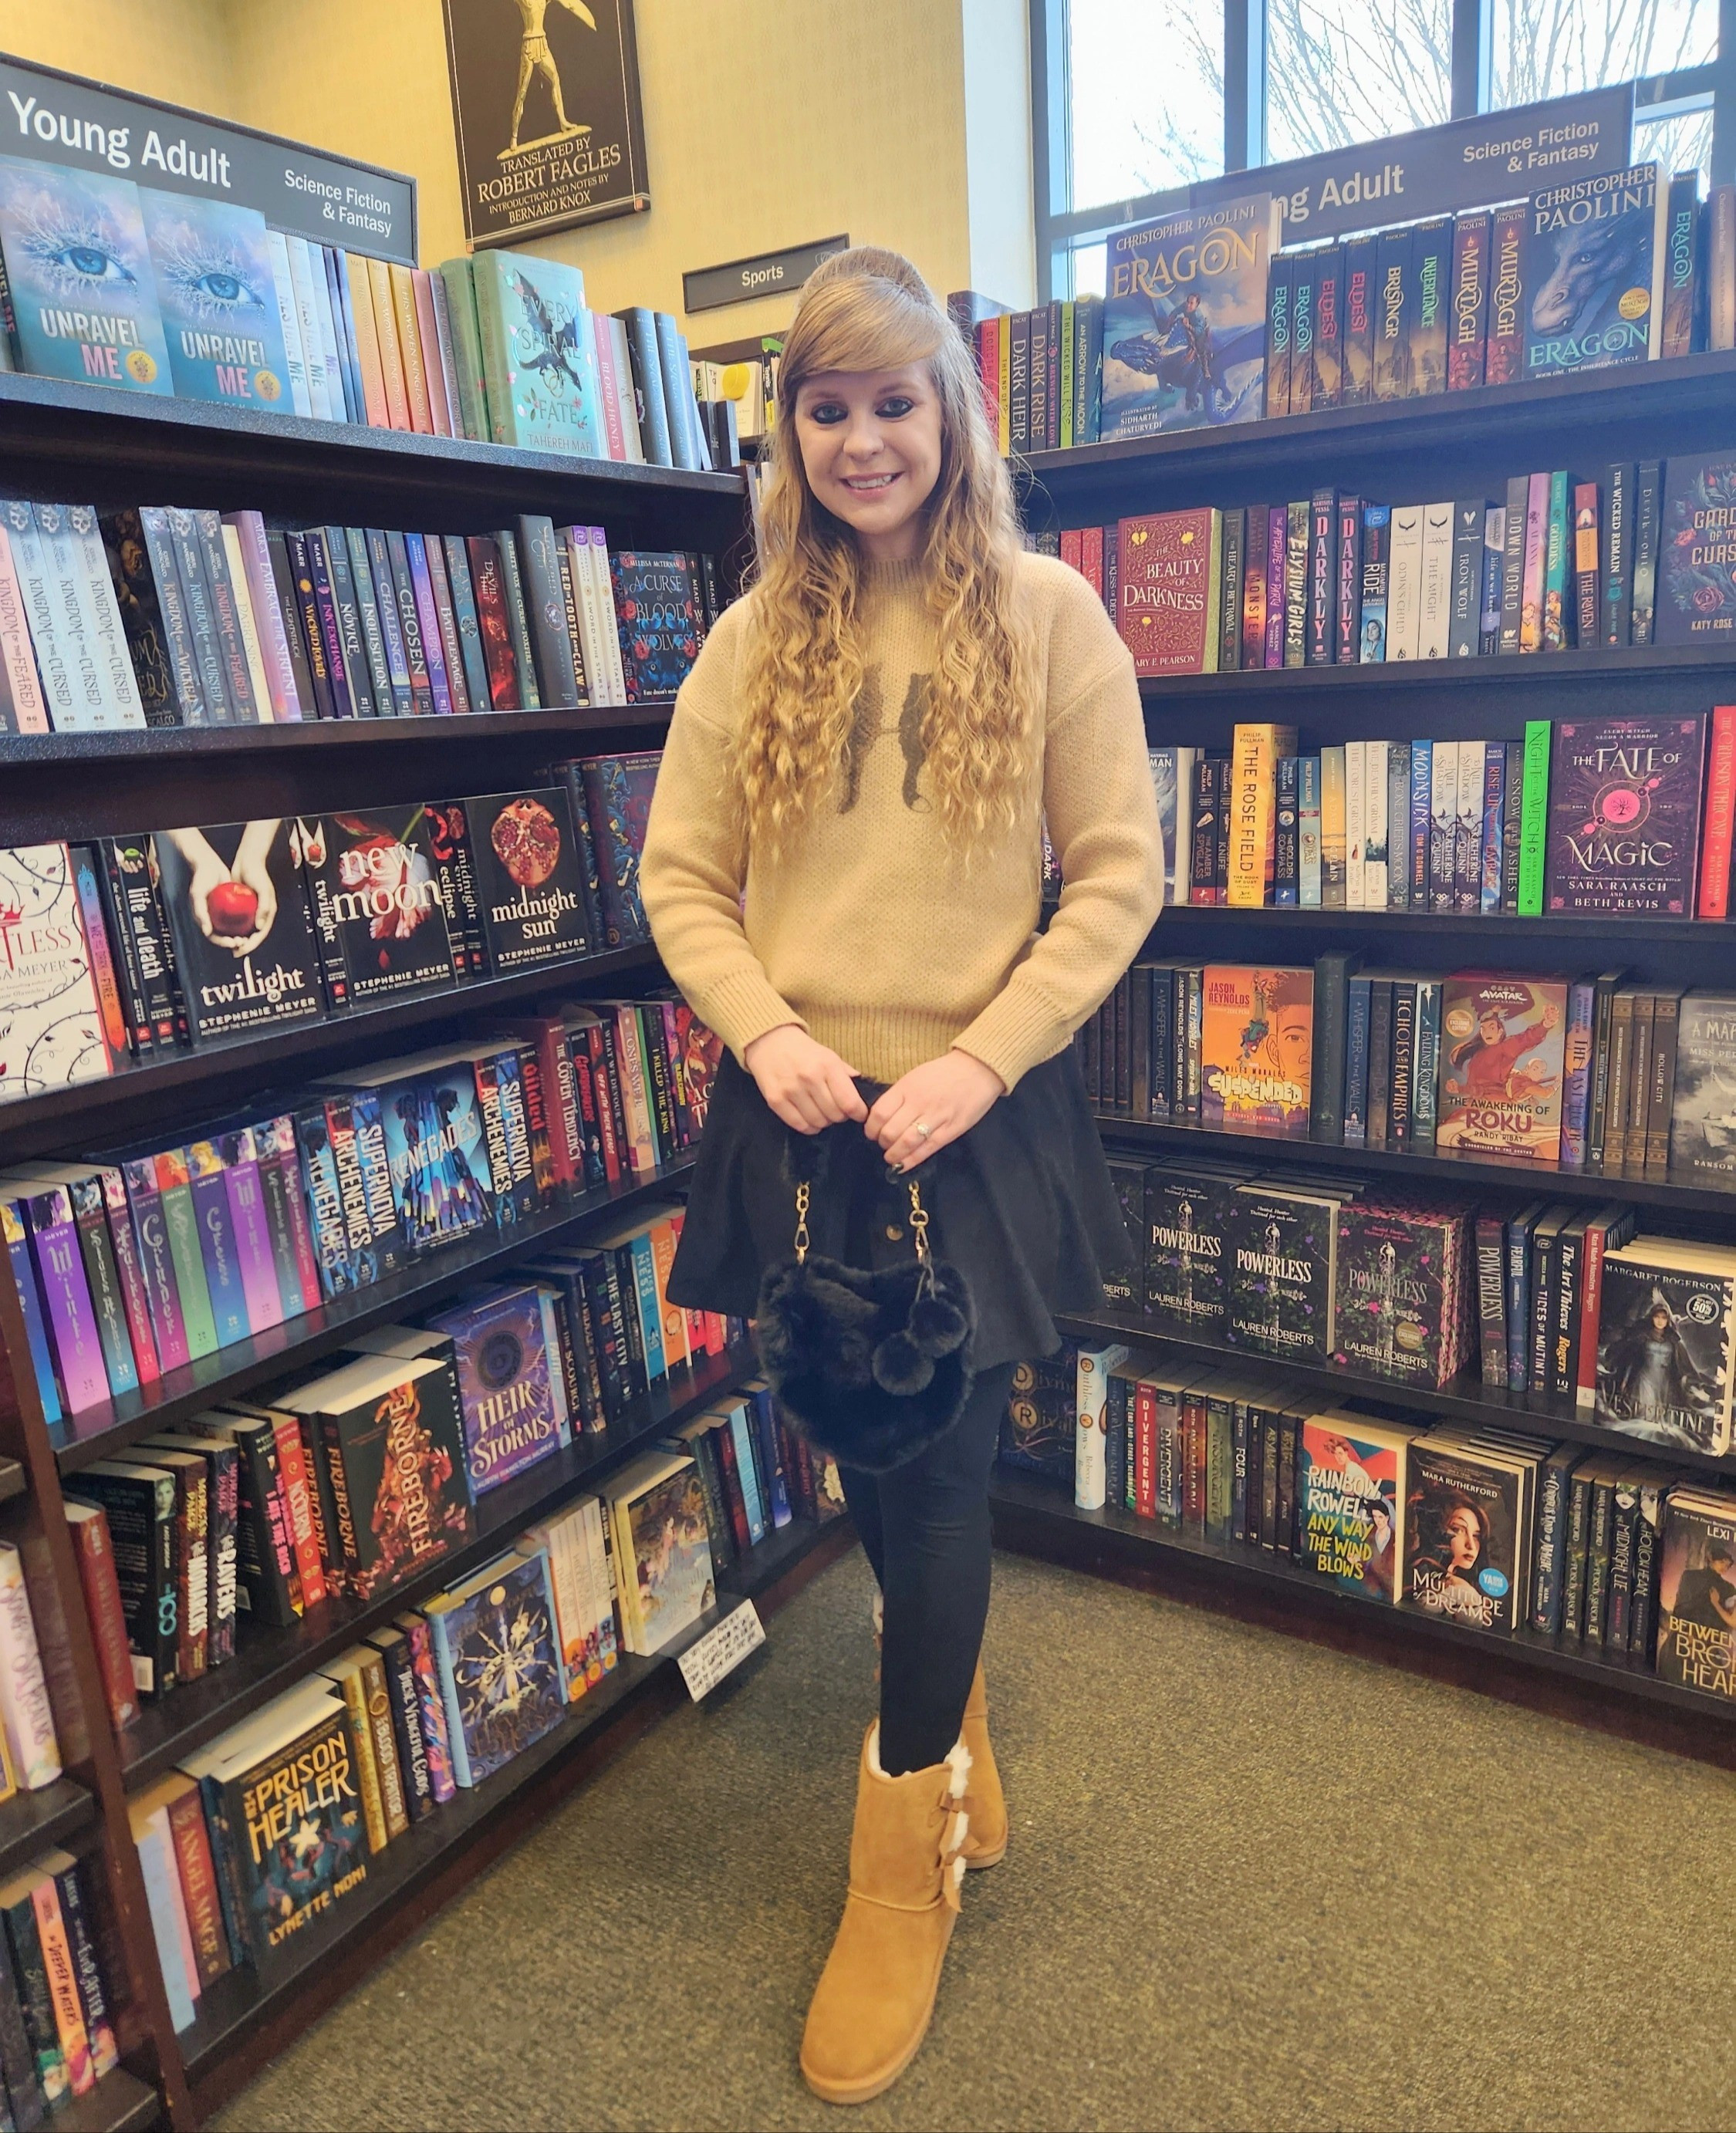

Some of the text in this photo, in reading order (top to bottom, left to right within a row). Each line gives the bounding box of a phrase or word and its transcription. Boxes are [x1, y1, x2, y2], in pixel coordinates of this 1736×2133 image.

[7, 90, 231, 188] Young Adult
[501, 136, 590, 174] TRANSLATED BY
[1464, 120, 1599, 163] Science Fiction
[478, 143, 621, 203] ROBERT FAGLES
[1507, 142, 1599, 173] & Fantasy
[285, 169, 391, 214] Science Fiction
[489, 174, 610, 214] INTRODUCTION AND NOTES BY
[1319, 165, 1404, 210] Adult
[1535, 165, 1655, 210] CHRISTOPHER
[323, 202, 392, 238] & Fantasy
[508, 190, 591, 224] BERNARD KNOX
[1534, 183, 1654, 236] PAOLINI
[1116, 220, 1193, 251] CHRISTOPHER
[1198, 205, 1255, 228] PAOLINI
[741, 264, 784, 289] Sports
[1112, 227, 1258, 299] ERAGON
[1385, 266, 1403, 340] BRISINGR
[1456, 248, 1481, 344] MURTAGH
[1495, 240, 1520, 337] MURTAGH
[40, 308, 145, 350] UNRAVEL
[1273, 285, 1288, 353] ERAGON
[81, 343, 123, 380] ME
[181, 331, 271, 368] UNRAVEL
[1529, 322, 1649, 369] ERAGON
[1580, 359, 1619, 371] INHERITANCE
[1621, 356, 1639, 365] CYCLE
[215, 365, 252, 399] ME
[1012, 339, 1027, 440] DARK HEIR
[1032, 334, 1045, 437] DARK RISE
[539, 400, 577, 424] FATE
[1116, 422, 1162, 435] CHATURVEDI
[1120, 412, 1157, 426] SIDHARTH
[527, 432, 593, 453] TAHEREH MAFI
[296, 543, 305, 567] MARR
[313, 543, 323, 567] MARR
[630, 559, 652, 568] MELISSA
[1156, 545, 1169, 557] THE
[630, 575, 682, 593] A CURSE
[1147, 559, 1204, 581] BEAUTY
[1176, 578, 1186, 586] OF
[1314, 516, 1328, 639] DARKLY
[1341, 518, 1353, 641] DARKLY
[1363, 564, 1380, 595] RIDE
[636, 602, 687, 621] BLOOD
[1123, 585, 1204, 610] DARKNESS
[28, 578, 72, 707] KINGDOM CURSED
[400, 589, 425, 676] CHOSEN
[637, 634, 692, 651] WOLVES
[1691, 618, 1733, 631] KATY ROSE
[1159, 654, 1196, 667] PEARSON
[1572, 743, 1682, 779] THE FATE OF
[1413, 747, 1430, 827] MOONSICK
[1240, 746, 1258, 872] THE ROSE FIELD
[339, 842, 418, 879] new
[332, 879, 443, 922] moon
[491, 886, 578, 922] midnight
[1569, 881, 1667, 892] SARA RAASCH
[1575, 897, 1659, 909] BETH REVIS
[128, 888, 163, 979] life and death
[522, 916, 556, 940] sun
[201, 956, 305, 1007] twilight
[354, 974, 413, 991] STEPHENIE
[416, 963, 449, 977] MEYER
[1209, 981, 1234, 994] JASON
[199, 1007, 271, 1028] STEPHENIE
[275, 997, 316, 1011] MEYER
[1209, 993, 1250, 1004] REYNOLDS
[1479, 990, 1528, 1001] AVATAR
[1397, 1000, 1411, 1055] ECHOES
[1207, 1074, 1302, 1104] SUSPENDED
[1393, 1065, 1409, 1121] EMPIRES
[1449, 1096, 1550, 1115] THE AWAKENING OF
[1467, 1109, 1532, 1132] ROKU
[1474, 1131, 1523, 1142] RANDY RIBAY
[388, 1111, 478, 1188] RENEGADES
[1694, 1160, 1733, 1170] RANSOM
[332, 1129, 373, 1250] ARCHENEMIES
[358, 1124, 397, 1237] SUPERNOVA
[1152, 1226, 1221, 1257] POWERLESS
[1237, 1249, 1312, 1283] POWERLESS
[1478, 1247, 1503, 1321] POWERLESS
[1606, 1264, 1721, 1292] MARGARET ROGERSON
[1150, 1291, 1224, 1315] LAUREN ROBERTS
[1556, 1244, 1574, 1373] The Art Thieves Rogers
[476, 1379, 537, 1429] HEIR
[471, 1416, 550, 1477] STORMS
[1236, 1447, 1245, 1478] FOUR
[389, 1396, 431, 1554] FIREBORNE
[1308, 1465, 1382, 1499] RAINBOW
[1421, 1470, 1498, 1497] MARA RUTHERFORD
[326, 1448, 357, 1558] FIREBORNE
[1308, 1488, 1373, 1520] ROWELL
[1308, 1513, 1374, 1538] ANY WAY
[1308, 1534, 1372, 1561] THE WIND
[1317, 1555, 1364, 1579] BLOWS
[1413, 1568, 1504, 1618] MULTITUDE
[1426, 1589, 1493, 1627] DREAMS
[256, 1731, 346, 1800] PRISON
[248, 1760, 357, 1864] HEALER
[269, 1865, 366, 1946] LYNETTE NONI
